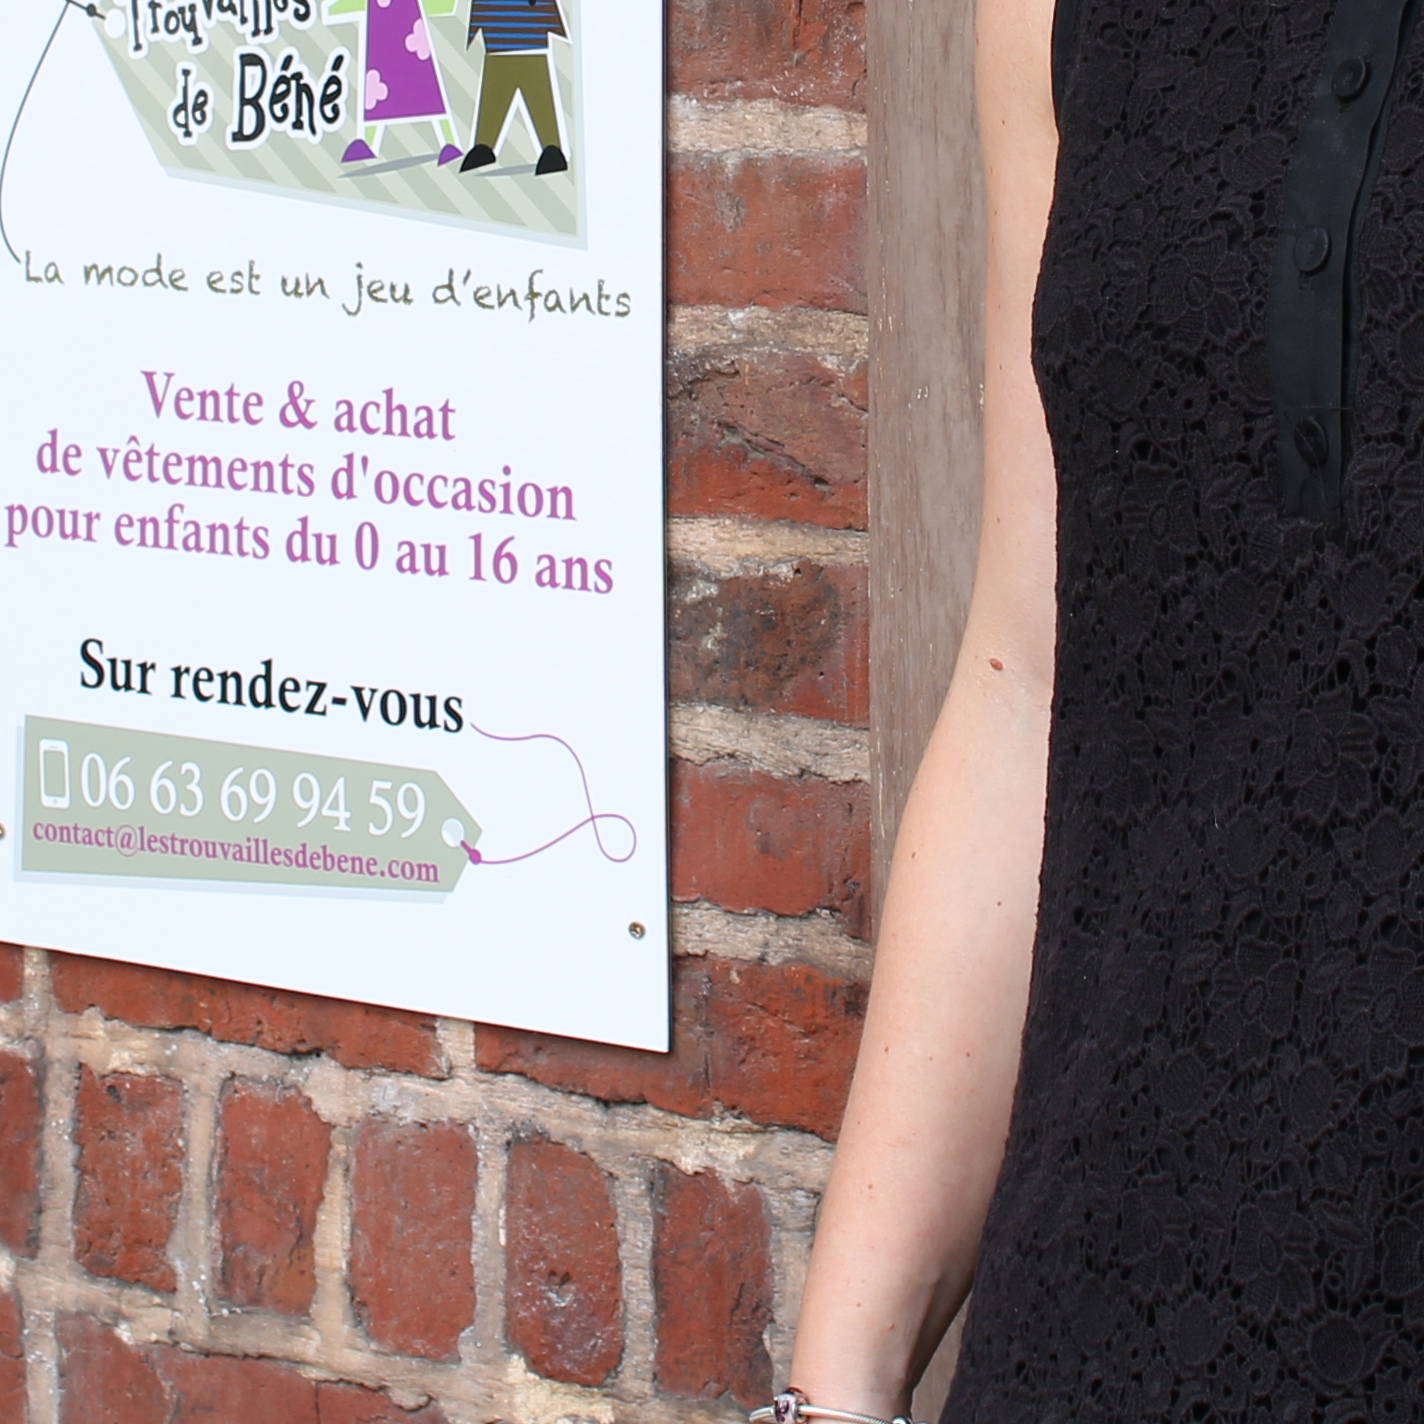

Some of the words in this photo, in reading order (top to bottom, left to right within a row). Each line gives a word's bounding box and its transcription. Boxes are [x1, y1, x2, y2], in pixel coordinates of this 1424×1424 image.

[172, 69, 207, 137] de
[231, 53, 344, 142] Béné
[23, 251, 65, 284] La
[84, 253, 188, 291] mode
[207, 261, 260, 295] est
[281, 269, 327, 298] un
[342, 264, 413, 316] jeu
[432, 268, 631, 322] d'enfants
[140, 370, 263, 424] Vente
[279, 380, 317, 429] &
[333, 388, 455, 440] achat
[36, 429, 81, 474] de
[98, 436, 315, 496] vêtements
[331, 454, 576, 520] d'occasion
[3, 502, 100, 547] pour
[114, 503, 270, 559] enfants
[285, 516, 338, 566] du
[355, 521, 379, 570] 0
[395, 538, 448, 576] au
[469, 532, 518, 584] 16
[535, 552, 614, 594] ans
[80, 637, 156, 695] Sur
[170, 658, 464, 733] rendez-vous
[80, 752, 134, 809] 06
[149, 761, 203, 817] 63
[220, 766, 275, 822] 69
[292, 771, 350, 832] 94
[368, 780, 425, 837] 59
[32, 818, 440, 883] contact@lestrouvaillesdebene.com
